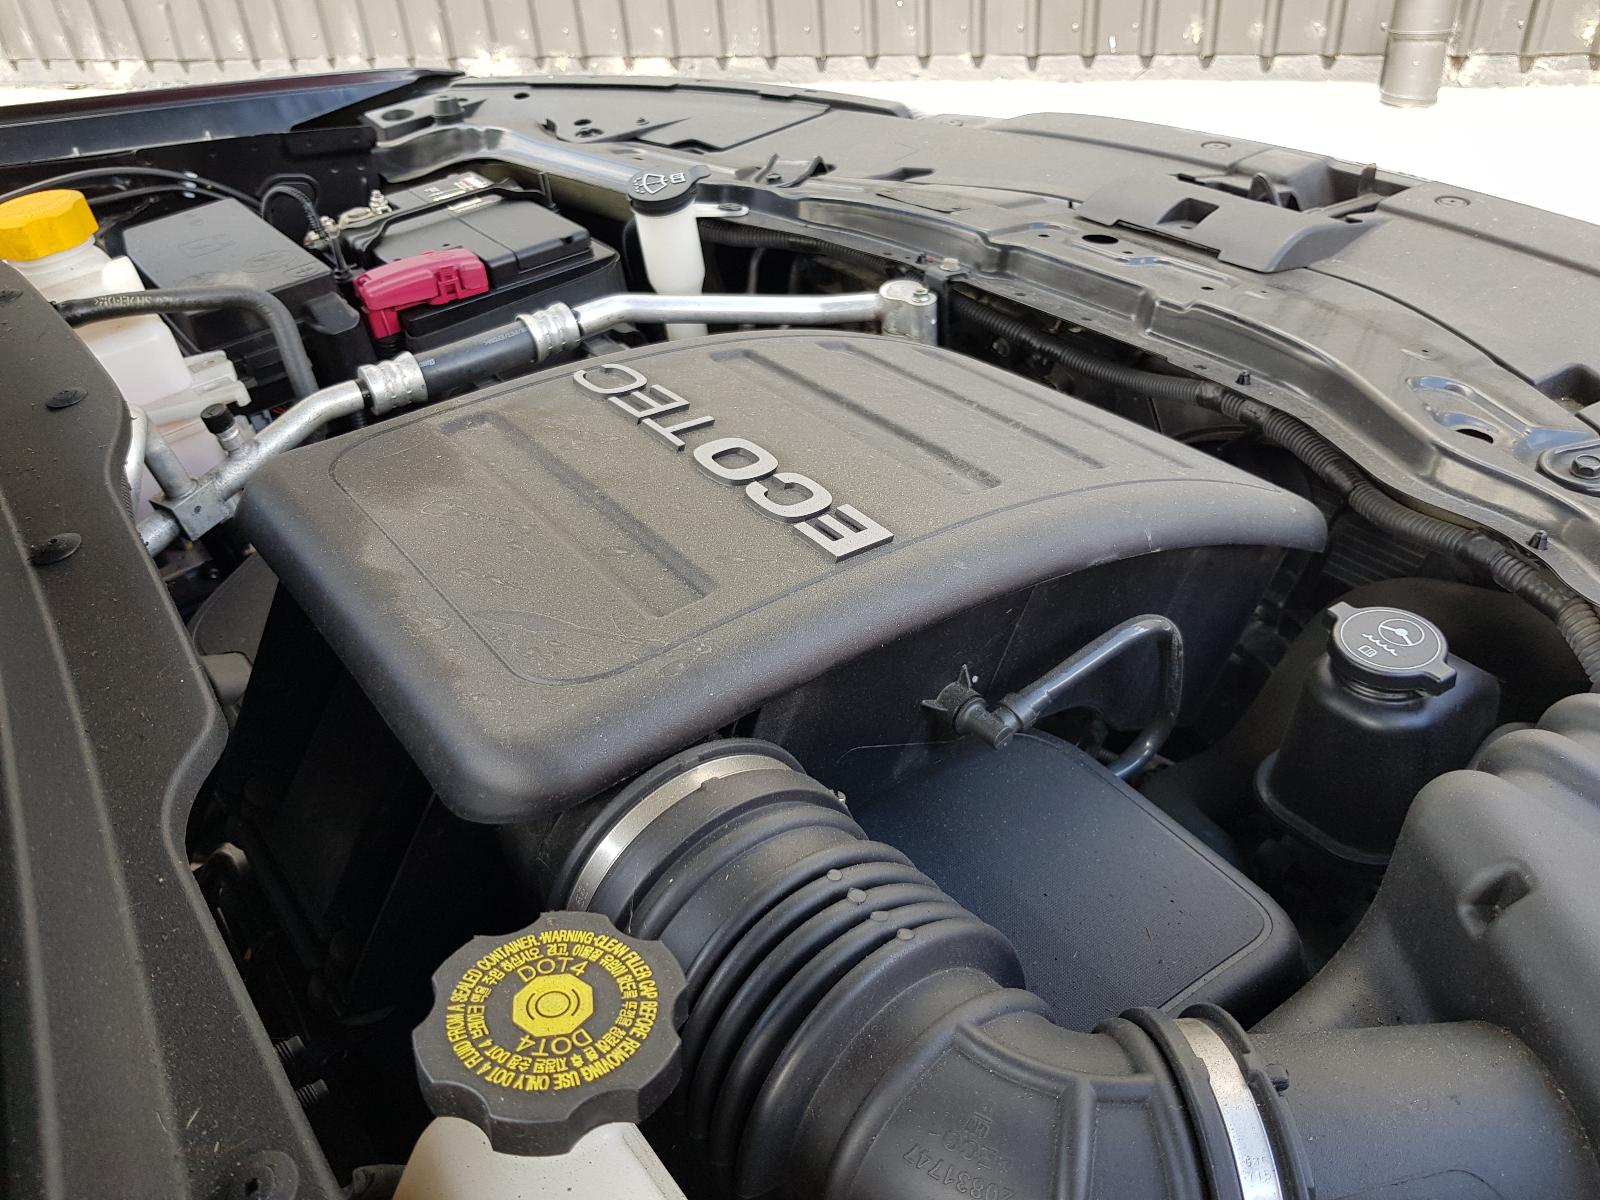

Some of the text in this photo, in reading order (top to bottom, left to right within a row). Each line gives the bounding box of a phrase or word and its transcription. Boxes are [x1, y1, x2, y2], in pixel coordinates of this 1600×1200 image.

[573, 363, 894, 564] ECOTEC
[572, 944, 604, 962] 이물질
[599, 953, 628, 978] 유입이
[621, 951, 653, 980] FILLER
[450, 968, 483, 1003] SEALED
[639, 979, 658, 999] CAP
[447, 1003, 466, 1012] A
[446, 1013, 468, 1042] FROM
[629, 1000, 658, 1040] BEFORE
[478, 1038, 493, 1048] 4
[453, 1039, 484, 1069] FLUID
[484, 1045, 511, 1064] DOT
[580, 1036, 640, 1082] REMOVING
[476, 1061, 492, 1076] 4
[484, 1067, 516, 1087] DOT
[512, 1074, 551, 1091] ONLY
[553, 1070, 581, 1090] USE
